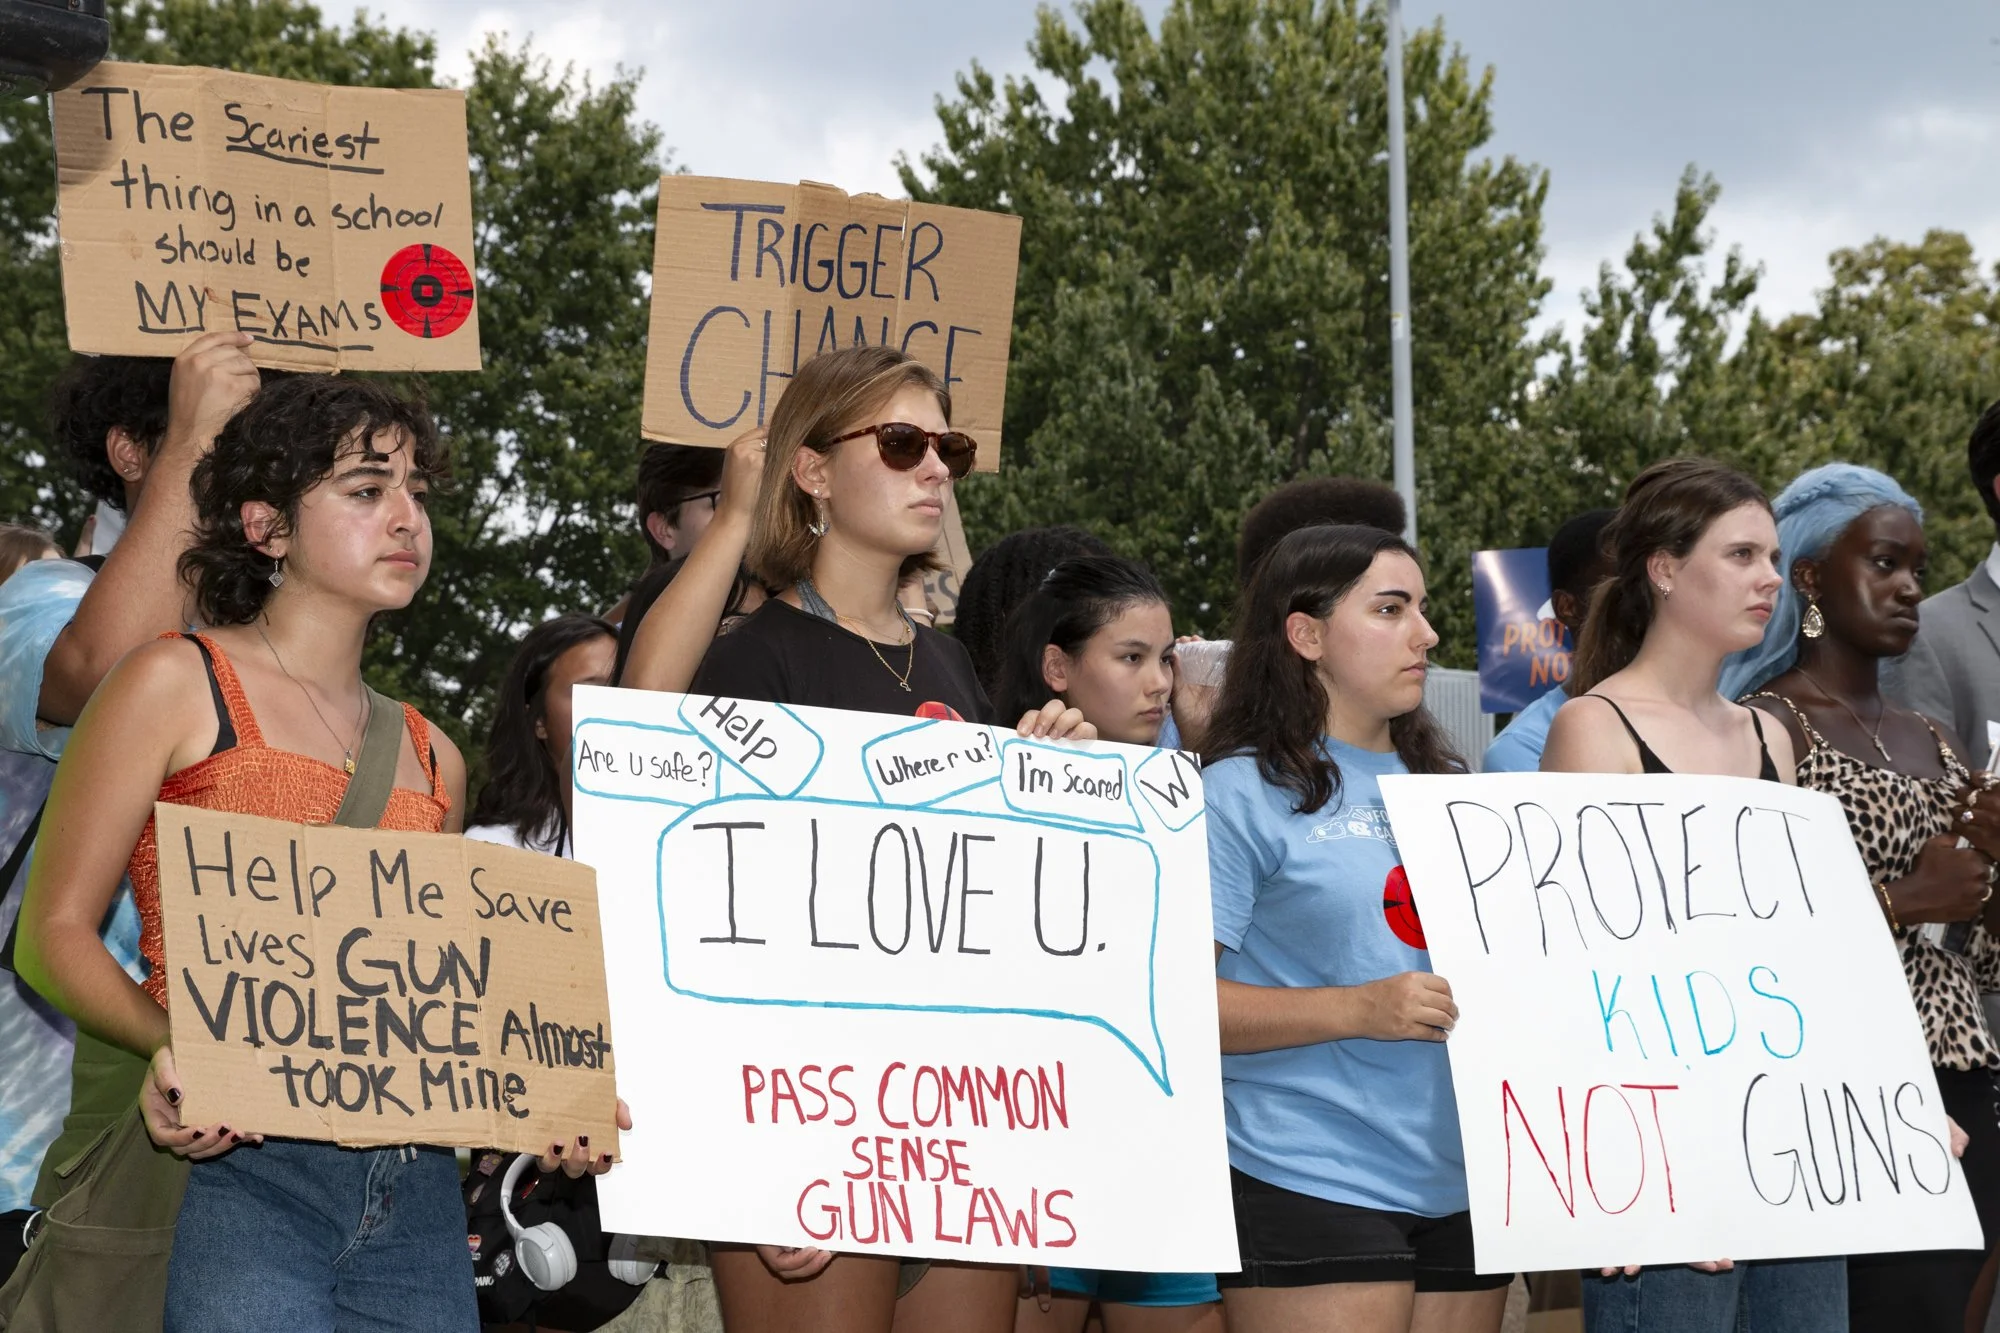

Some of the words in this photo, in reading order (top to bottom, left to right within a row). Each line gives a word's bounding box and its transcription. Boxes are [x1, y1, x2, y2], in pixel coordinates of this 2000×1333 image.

[81, 86, 194, 143] The
[225, 102, 380, 160] Scariest
[111, 158, 236, 231] thing
[254, 195, 280, 222] in
[294, 203, 316, 228] a
[330, 192, 444, 230] school
[155, 224, 256, 266] should
[276, 245, 310, 278] be
[700, 202, 944, 302] TRIGGER
[135, 280, 206, 329] MY
[233, 291, 381, 338] EXAMS
[680, 305, 982, 429] CHE
[1529, 651, 1570, 687] NO
[578, 739, 619, 773] Are
[700, 696, 777, 764] Help
[876, 755, 945, 786] Where
[947, 753, 959, 768] r
[965, 731, 993, 763] u?
[1018, 752, 1053, 793] I'm
[1063, 763, 1123, 801] Scared
[184, 826, 336, 918] Help
[369, 849, 444, 919] Me
[470, 867, 574, 932] Save
[692, 821, 766, 945] I
[810, 819, 996, 955] LOVE
[1034, 837, 1106, 956] U.
[1446, 801, 1815, 956] PROTECT
[198, 914, 314, 978] Lives
[336, 927, 490, 998] GUN
[182, 967, 481, 1056] VIOLENCE
[500, 1002, 611, 1070] Almost
[1592, 966, 1804, 1059] KIDS
[420, 1058, 530, 1119] Mine
[742, 1064, 857, 1126] PASS
[878, 1061, 1069, 1131] COMMON
[842, 1135, 973, 1186] SENSE
[1502, 1079, 1679, 1226] NOT
[1742, 1073, 1952, 1211] GUNS
[796, 1179, 914, 1244] GUN
[934, 1184, 1077, 1249] LAWS
